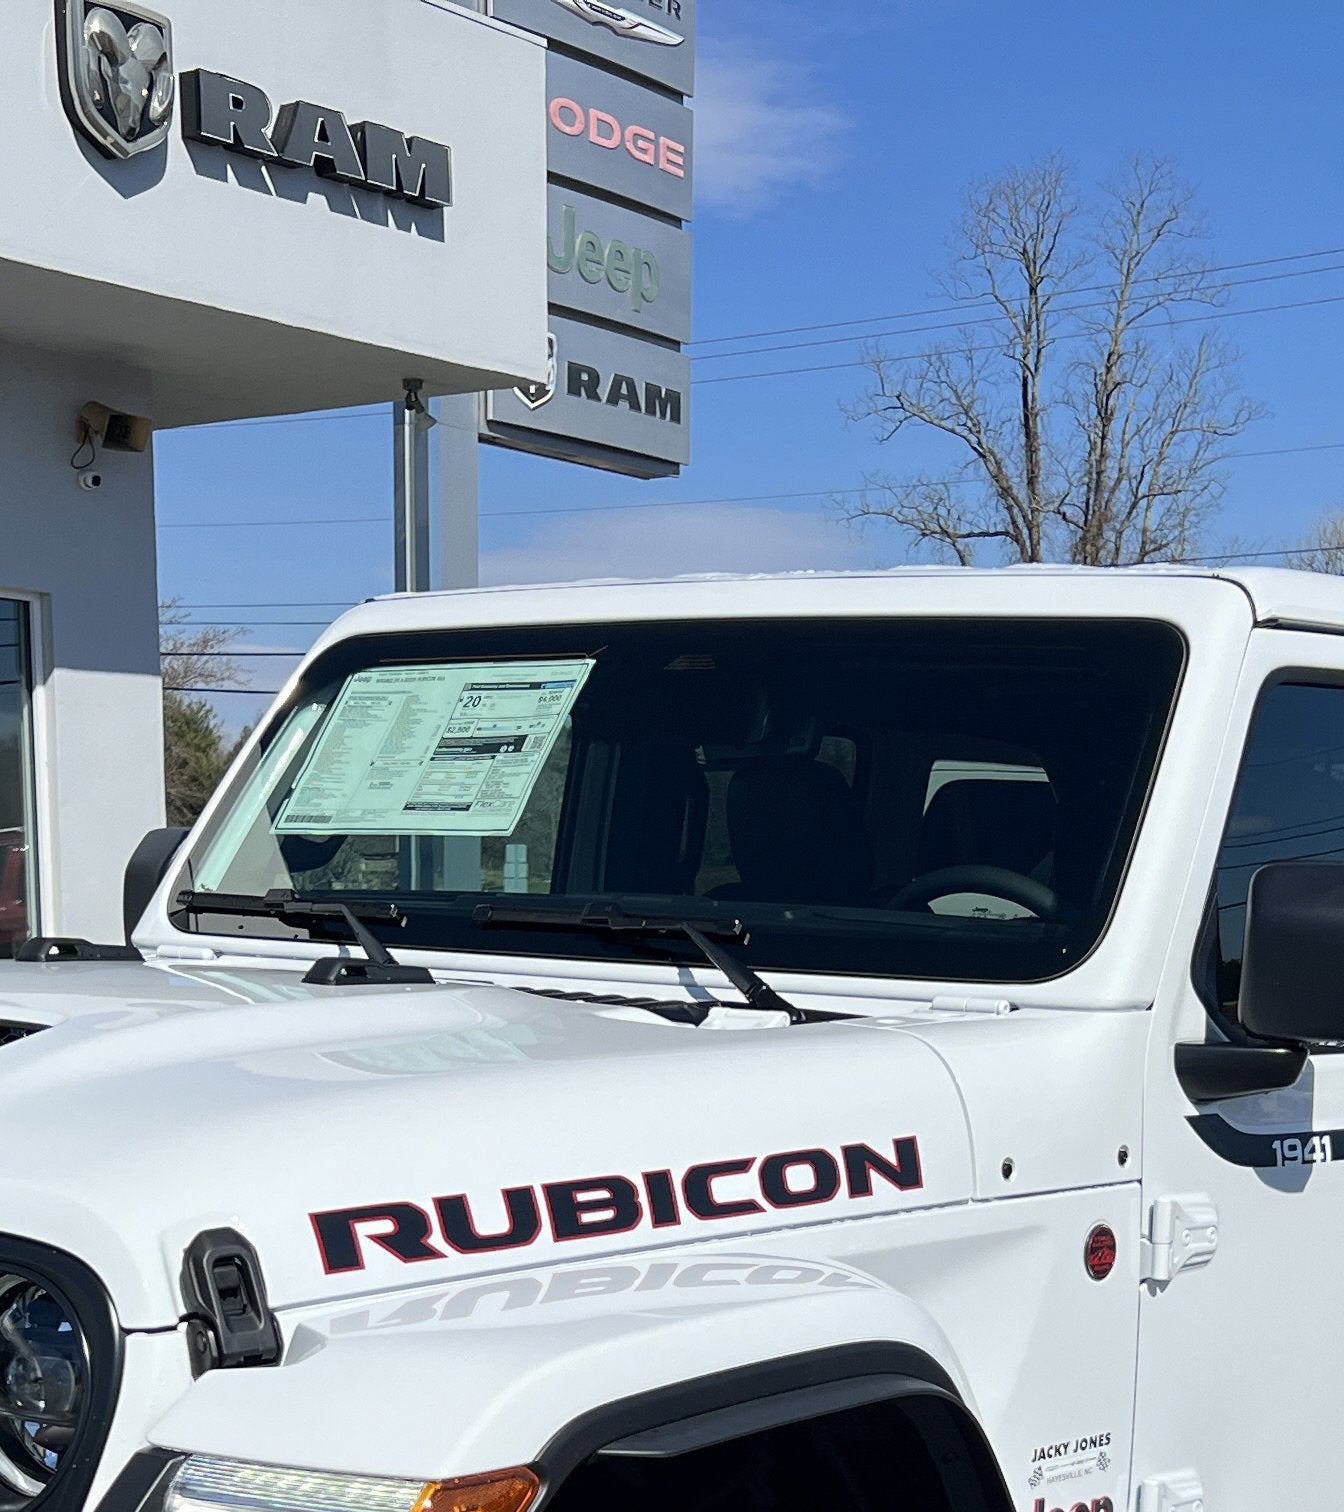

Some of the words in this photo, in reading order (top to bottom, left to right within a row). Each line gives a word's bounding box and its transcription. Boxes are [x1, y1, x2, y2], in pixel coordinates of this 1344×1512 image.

[179, 68, 453, 208] RAM
[548, 97, 685, 178] ODGE
[547, 204, 659, 313] Jeep
[566, 360, 682, 425] RAM
[1271, 1134, 1333, 1168] 1941
[307, 1135, 924, 1275] RUBICON
[1031, 1440, 1071, 1463] JACKY
[1073, 1432, 1112, 1454] JONES
